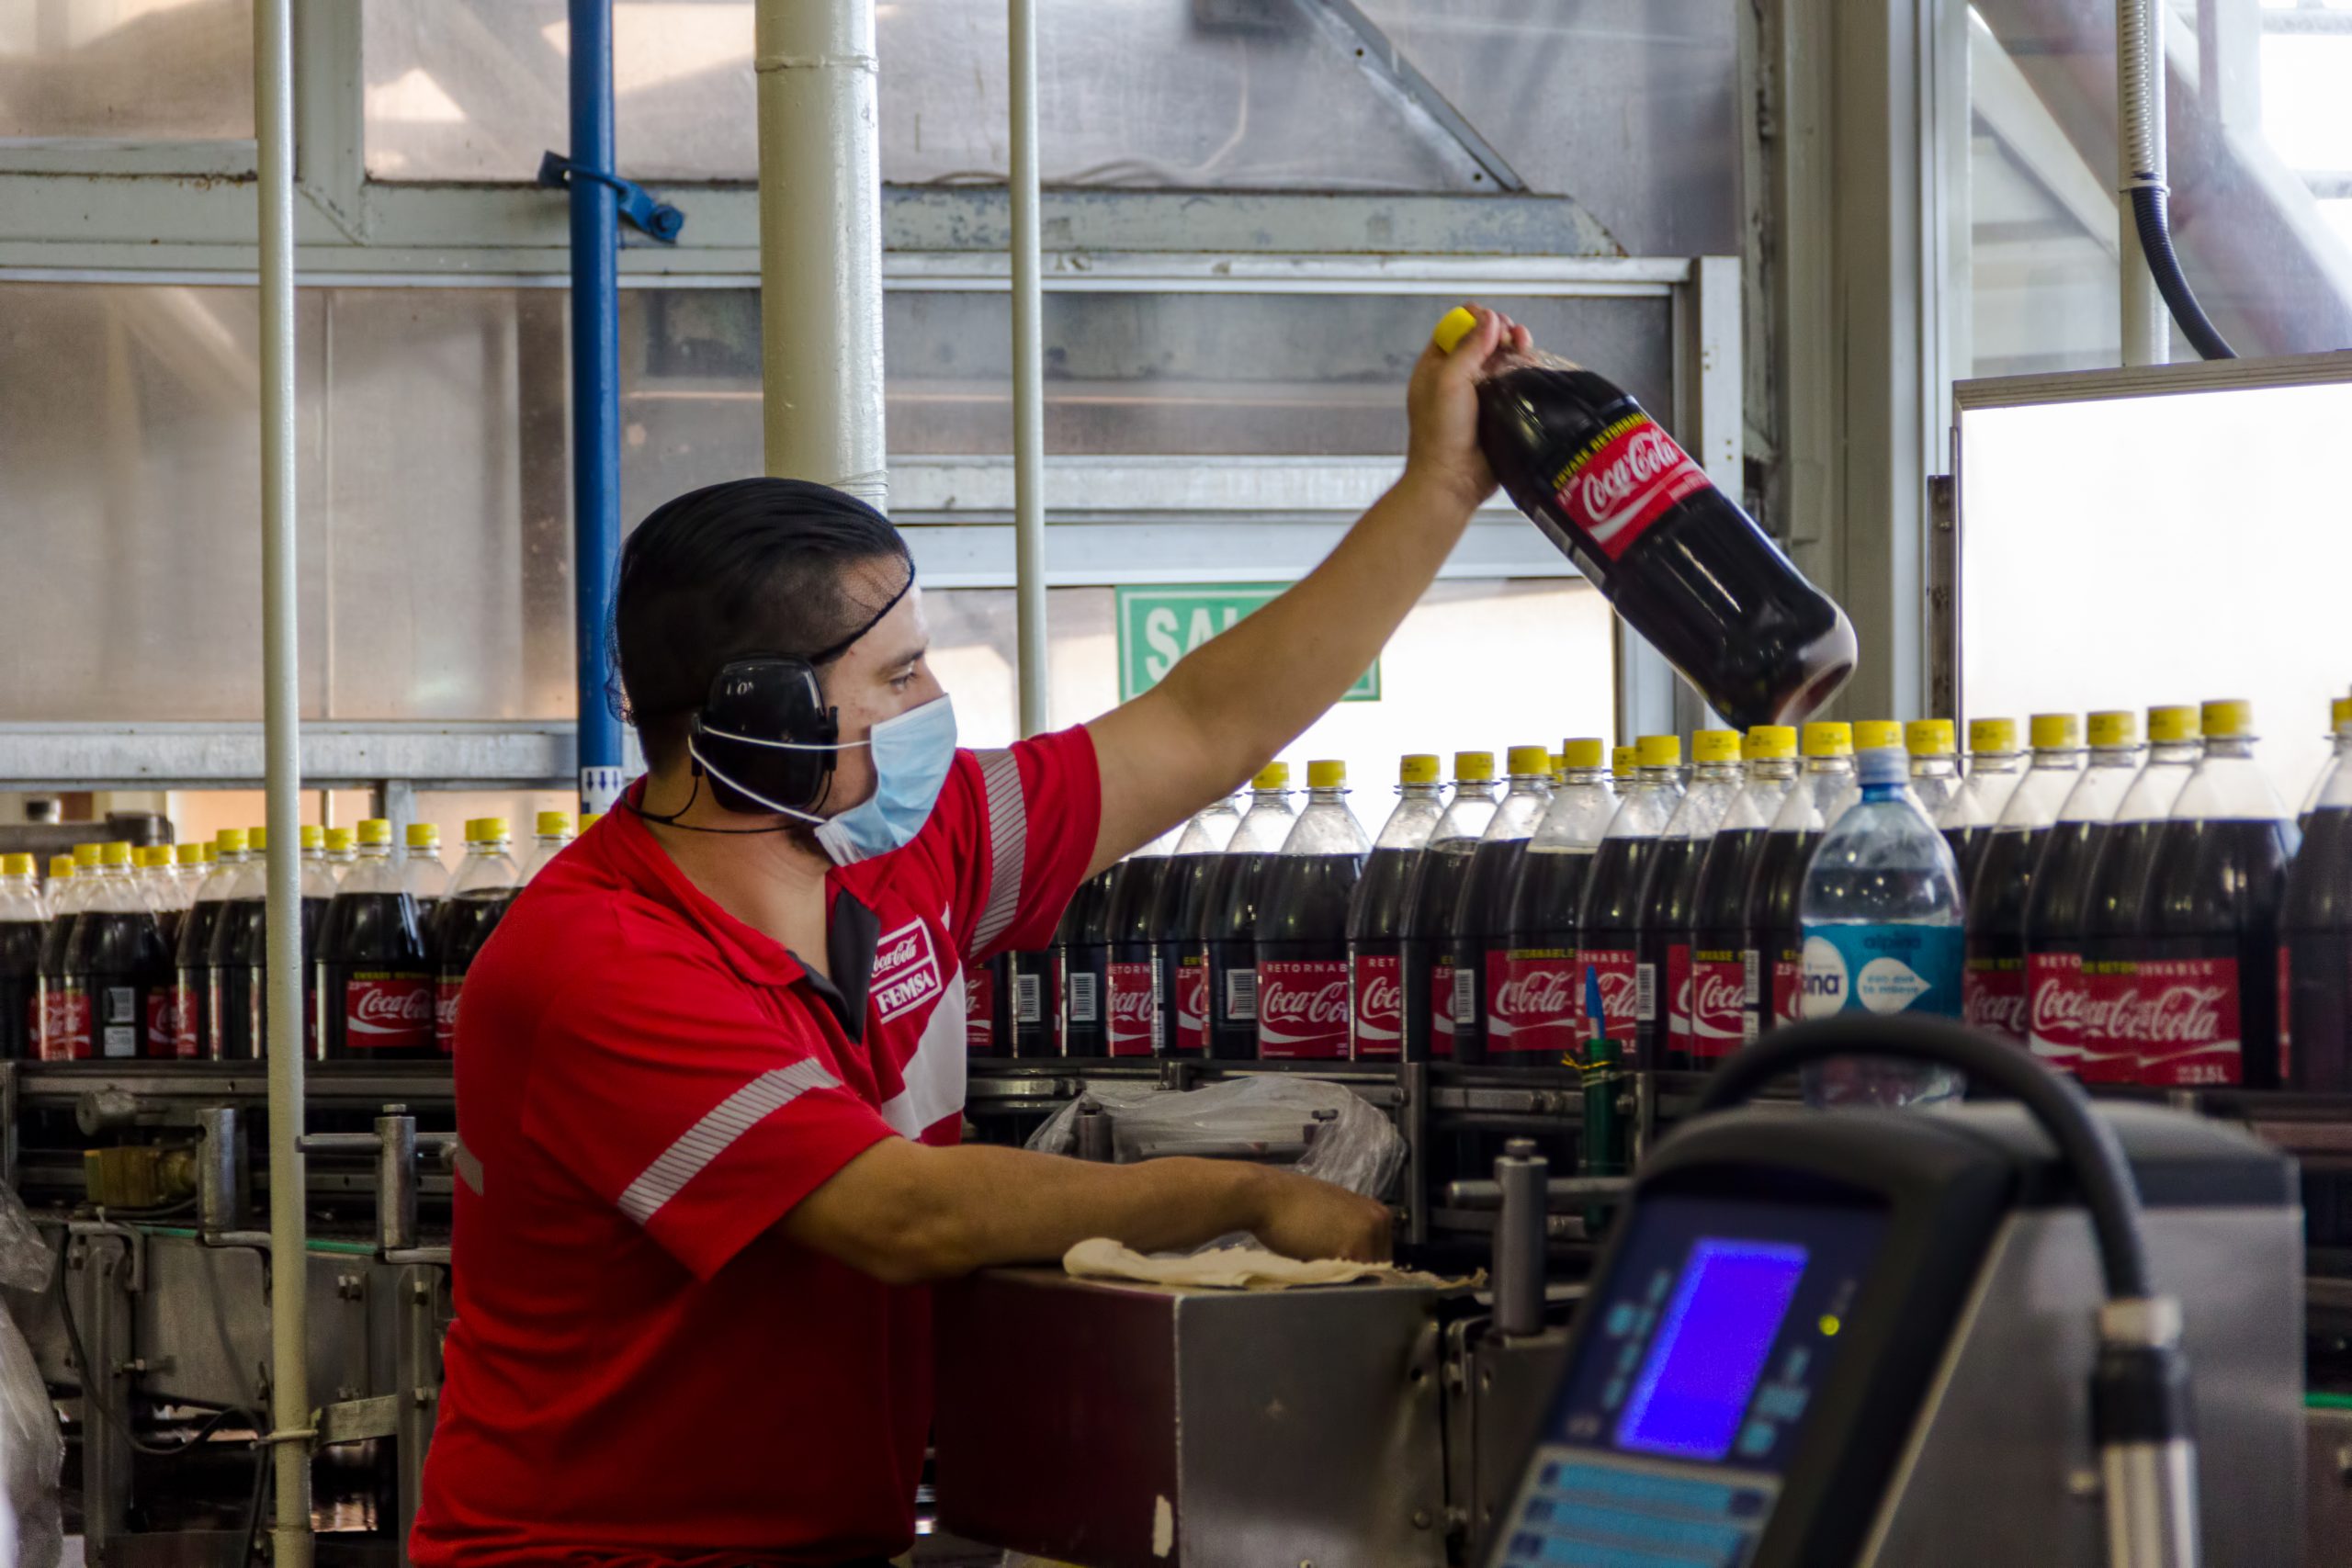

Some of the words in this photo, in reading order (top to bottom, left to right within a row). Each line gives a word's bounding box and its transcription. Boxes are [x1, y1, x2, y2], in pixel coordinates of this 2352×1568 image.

[1582, 428, 1679, 523] Coca-Cola
[872, 933, 918, 978] oca-Cola
[1368, 958, 1396, 967] RET
[875, 969, 936, 1014] FEMSA
